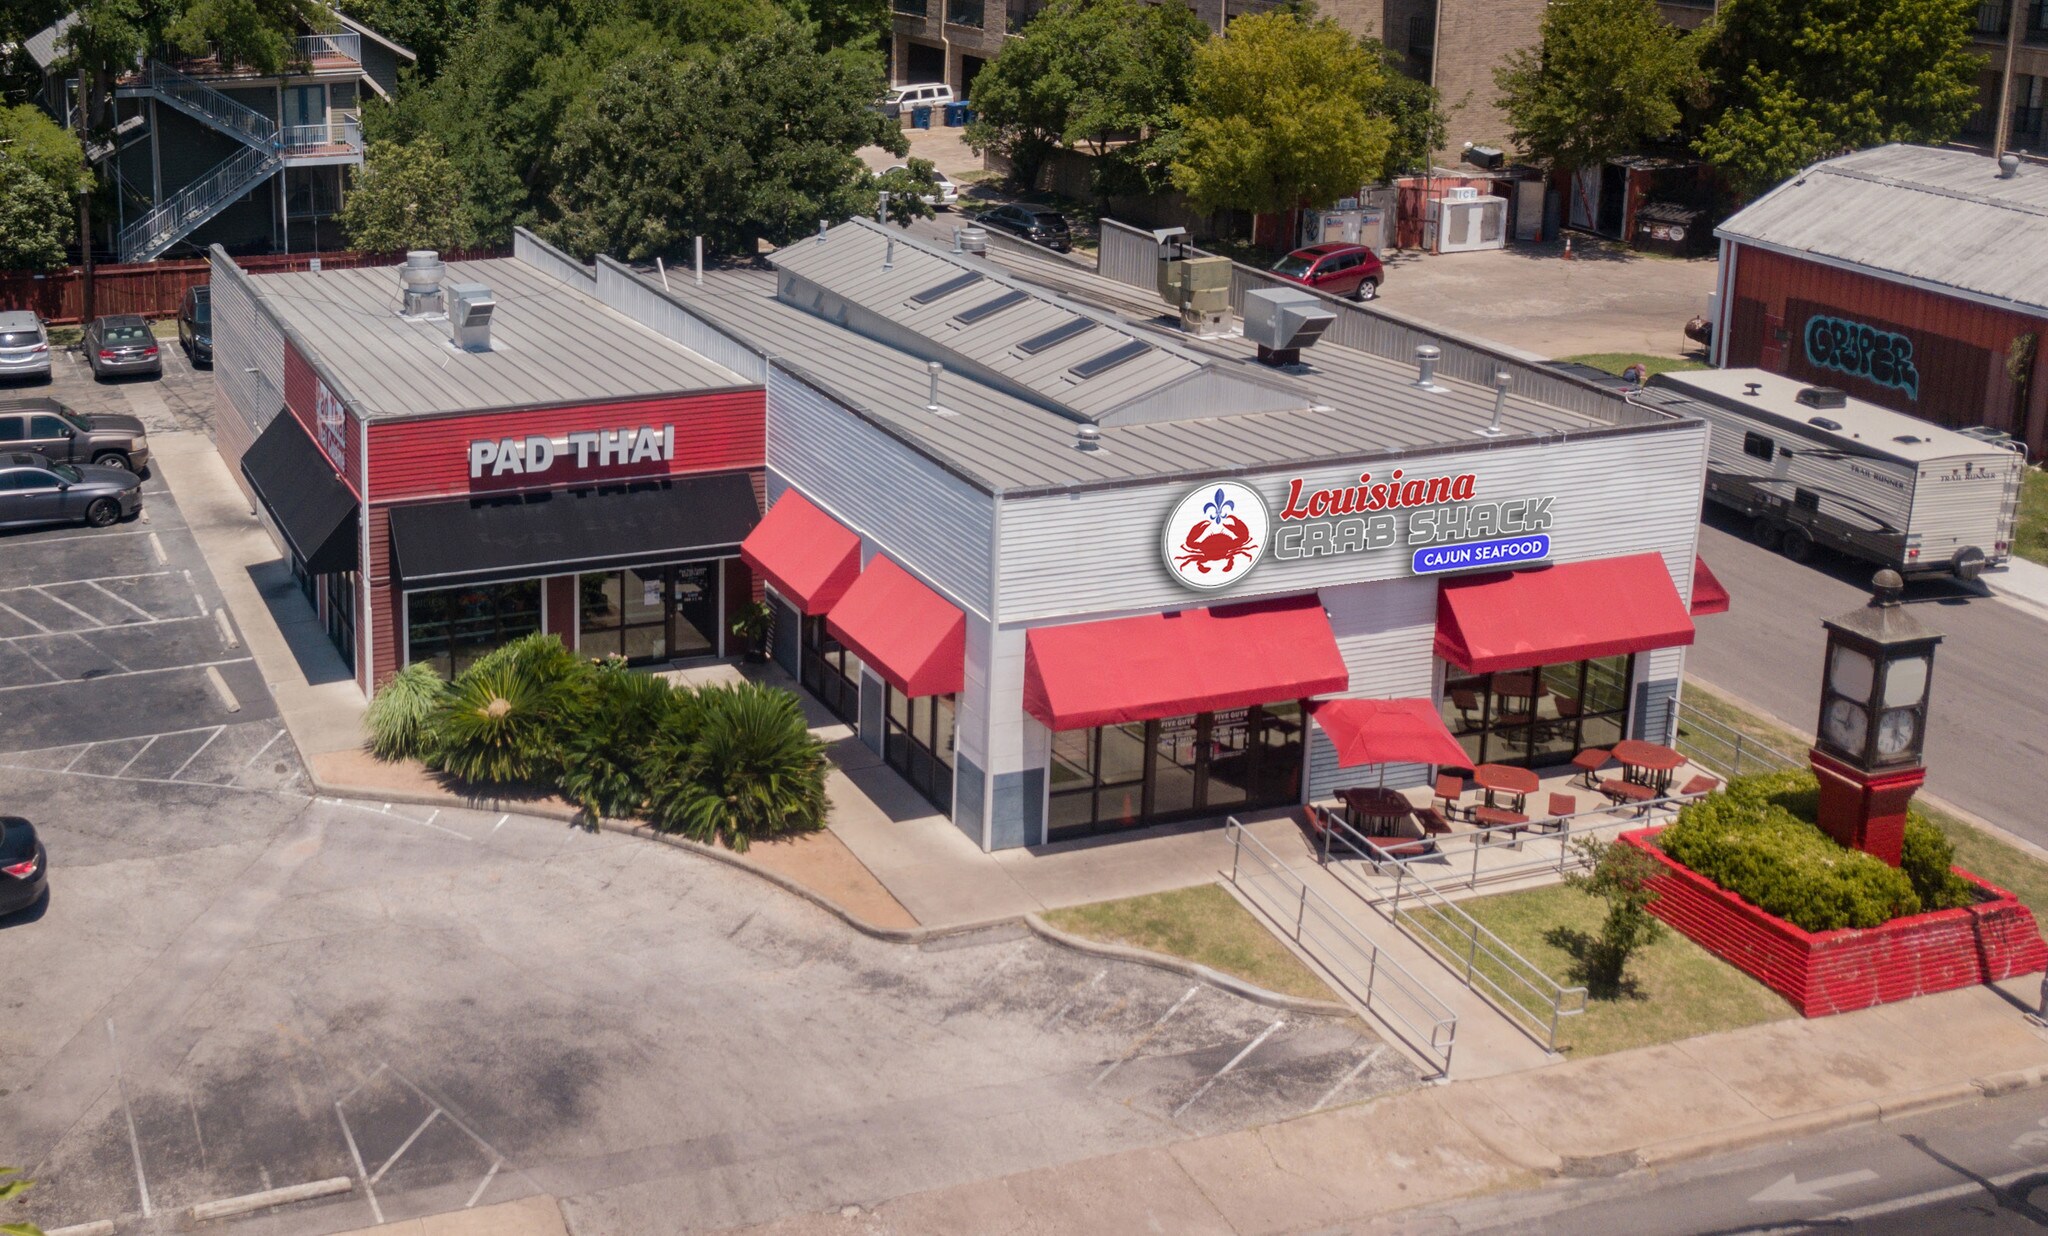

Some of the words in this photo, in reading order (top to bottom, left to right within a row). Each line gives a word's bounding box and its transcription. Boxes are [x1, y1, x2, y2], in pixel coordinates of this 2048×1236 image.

[1459, 190, 1475, 199] ICE
[470, 434, 554, 478] PAD
[568, 424, 675, 468] THAI
[1851, 465, 1870, 477] TRAIL
[1873, 473, 1904, 489] RUNNER
[1940, 474, 1961, 482] TRAIL
[1965, 473, 1996, 481] RUNNER
[1280, 469, 1478, 521] Louisiana
[1275, 515, 1397, 561] CRAB
[1408, 496, 1557, 545] SHACK
[1424, 548, 1471, 567] CAJUN
[1475, 540, 1542, 560] SEAFOOD
[1161, 720, 1176, 728] FIVE
[1177, 718, 1195, 726] GUYS
[1214, 712, 1230, 721] FIVE
[1230, 710, 1249, 718] GUYS
